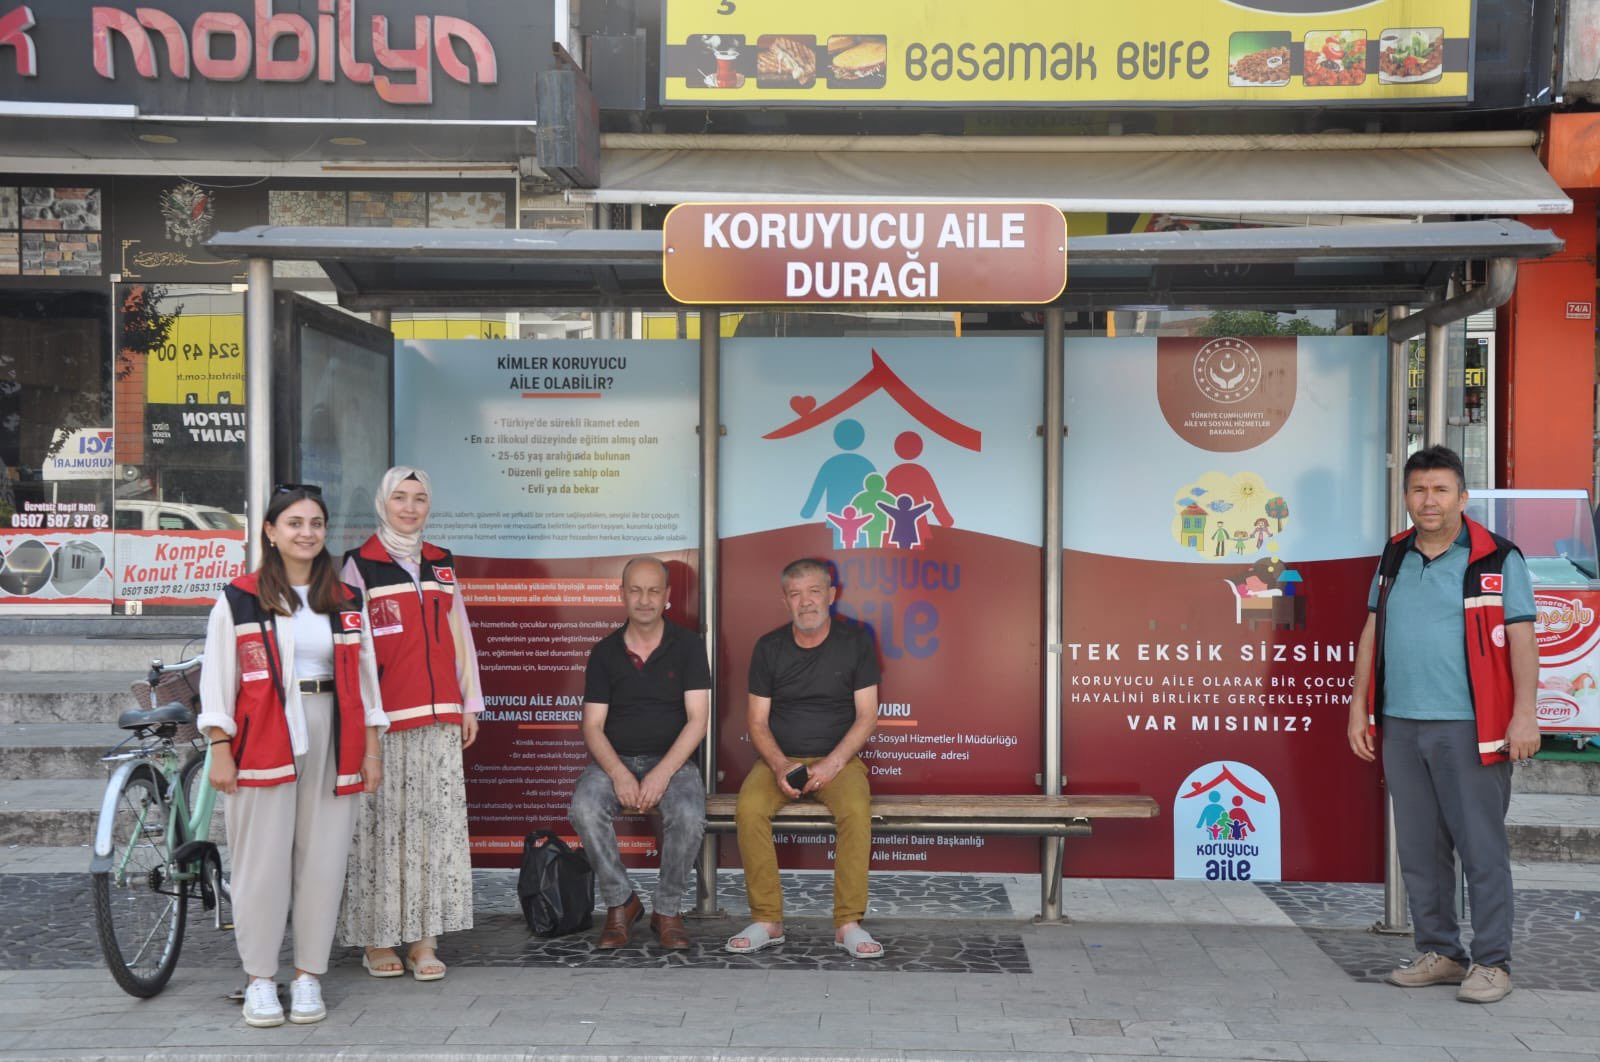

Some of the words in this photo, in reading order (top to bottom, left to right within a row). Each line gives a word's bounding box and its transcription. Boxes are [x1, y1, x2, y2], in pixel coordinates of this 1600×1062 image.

[704, 212, 925, 249] KORUYUCU
[786, 252, 939, 298] DURAĞI
[1569, 304, 1589, 313] 74/A
[497, 354, 549, 370] KİMLER
[552, 356, 627, 371] KORUYUCU
[510, 373, 540, 390] AİLE
[543, 374, 614, 390] OLABİLİR?
[501, 418, 547, 430] Türkiye'de
[550, 418, 582, 429] sürekli
[584, 418, 615, 429] ikamet
[617, 418, 640, 429] eden
[471, 435, 482, 445] En
[484, 436, 495, 445] az
[497, 434, 529, 445] ilkokul
[531, 434, 578, 447] düzeyinde
[580, 434, 609, 447] eğitim
[611, 434, 636, 447] almış
[638, 434, 658, 445] olan
[498, 451, 525, 462] 25-65
[527, 452, 544, 463] yaş
[546, 450, 592, 463] aralığında
[594, 451, 631, 462] bulunan
[508, 466, 542, 478] Düzenli
[544, 467, 571, 480] gelire
[573, 467, 598, 480] sahip
[600, 467, 620, 478] olan
[528, 483, 544, 494] Evli
[546, 486, 558, 497] ya
[560, 484, 571, 494] da
[573, 484, 600, 494] bekar
[11, 513, 44, 528] 0507
[47, 513, 72, 528] 587
[73, 514, 90, 528] 37
[92, 514, 109, 528] 82
[155, 541, 226, 561] Komple
[123, 565, 183, 583] Konut
[121, 586, 142, 596] 0507
[143, 586, 159, 595] 587
[160, 585, 171, 595] 37
[172, 585, 182, 594] 82
[189, 583, 210, 593] 0533
[1068, 643, 1121, 661] TEK
[1137, 640, 1223, 662] EKSİK
[1240, 640, 1356, 662] SİZSİNİ
[1072, 675, 1154, 687] KORUYUCU
[1162, 674, 1195, 687] AİLE
[1202, 676, 1263, 687] OLARAK
[1271, 674, 1296, 687] BİR
[529, 692, 553, 706] AİLE
[1071, 690, 1144, 704] HAYALİNİ
[1152, 690, 1220, 704] BİRLİKTE
[535, 710, 583, 721] GEREKEN
[1127, 715, 1177, 730] VAR
[1191, 716, 1313, 732] MISINIZ?
[878, 733, 908, 747] Sosyal
[910, 733, 956, 745] Hizmetler
[964, 733, 1018, 748] Müdürlüğü
[941, 749, 970, 761] adresi
[871, 765, 902, 776] Devlet
[791, 834, 827, 844] Yanında
[911, 834, 935, 845] Daire
[937, 834, 985, 848] Başkanlığı
[872, 850, 890, 861] Aile
[892, 850, 927, 861] Hizmeti
[1205, 859, 1251, 881] aile
